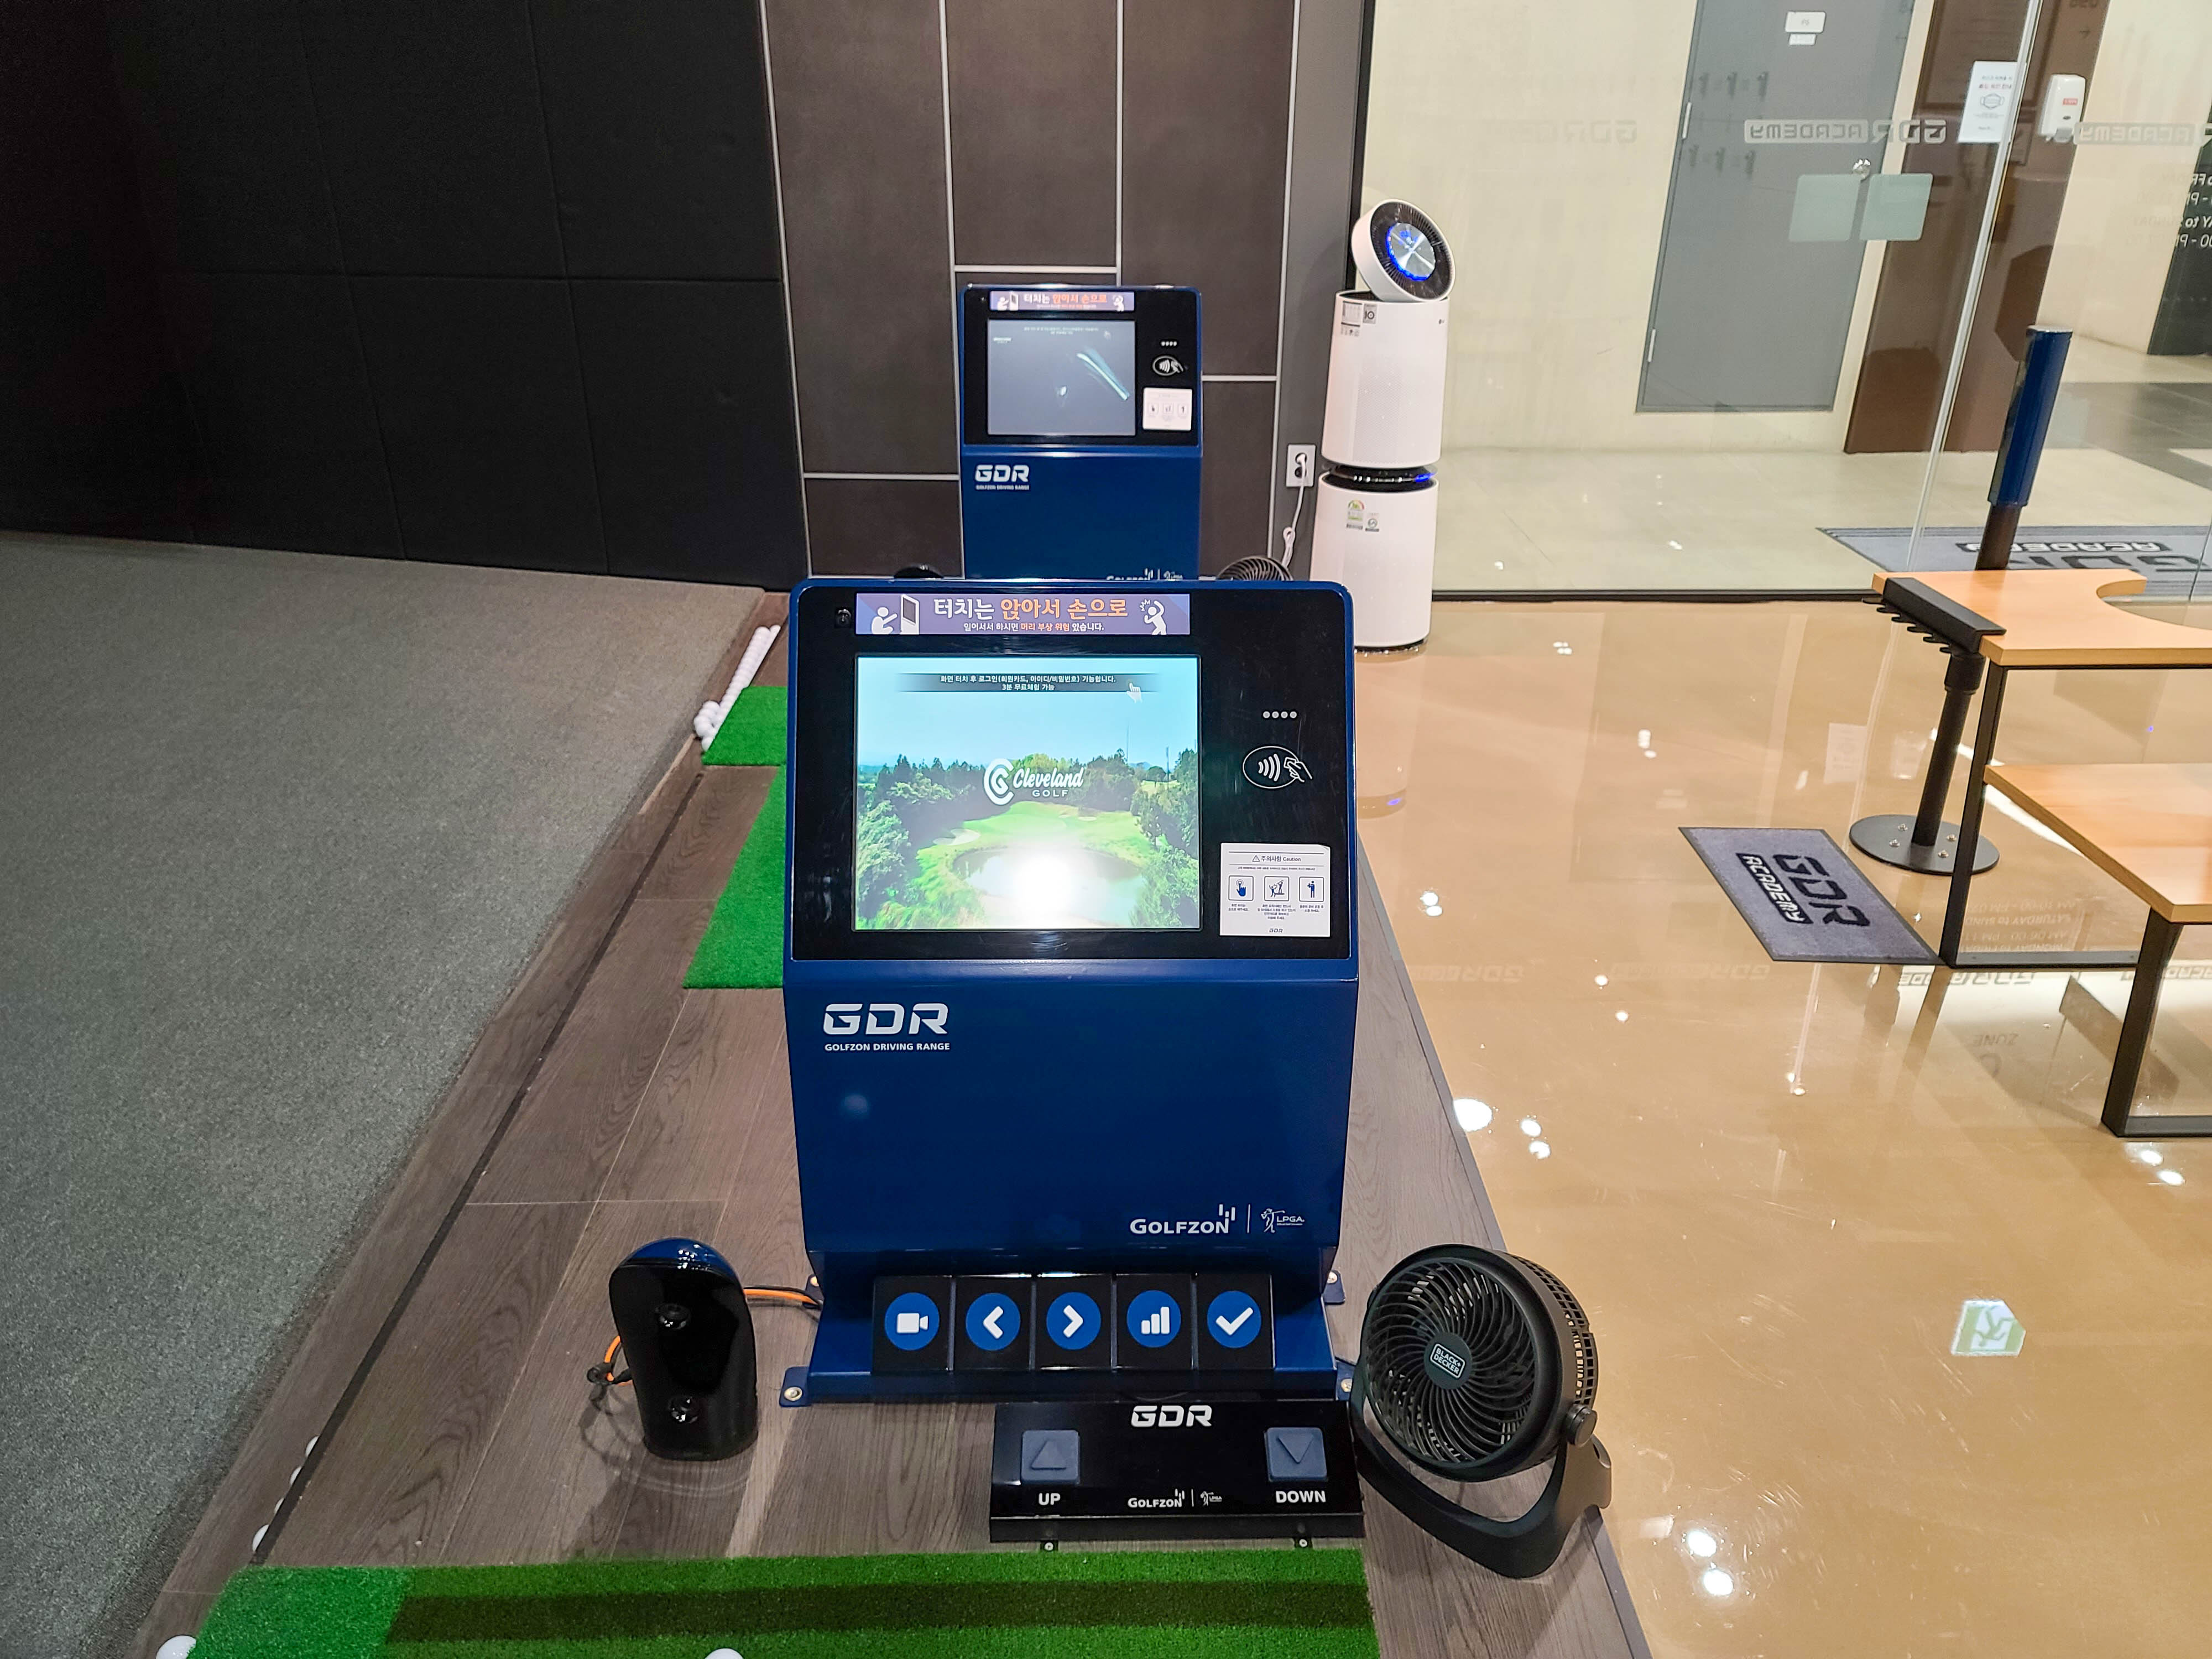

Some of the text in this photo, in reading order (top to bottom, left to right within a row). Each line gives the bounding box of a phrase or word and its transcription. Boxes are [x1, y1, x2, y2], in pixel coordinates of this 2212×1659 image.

[975, 465, 1029, 482] GDR
[1966, 542, 2160, 552] ACADE
[933, 598, 1128, 620] 터치는 앉아서 손으로
[964, 623, 1104, 632] 일어서서 하시면 머리 부상 위험 있습니다.
[1013, 766, 1085, 789] Cleveland
[1032, 789, 1068, 797] GOLF
[1742, 855, 1806, 922] ACADEMY
[1772, 854, 1870, 927] GDR
[823, 1003, 948, 1035] GDR
[825, 1043, 870, 1051] GOLFZON
[1130, 1218, 1229, 1234] GOLFZON
[1433, 1354, 1459, 1374] DECKER
[1131, 1405, 1212, 1427] GDR
[1038, 1492, 1061, 1506] UP
[1128, 1496, 1182, 1508] GOLFZON
[1275, 1490, 1326, 1504] DOWN
